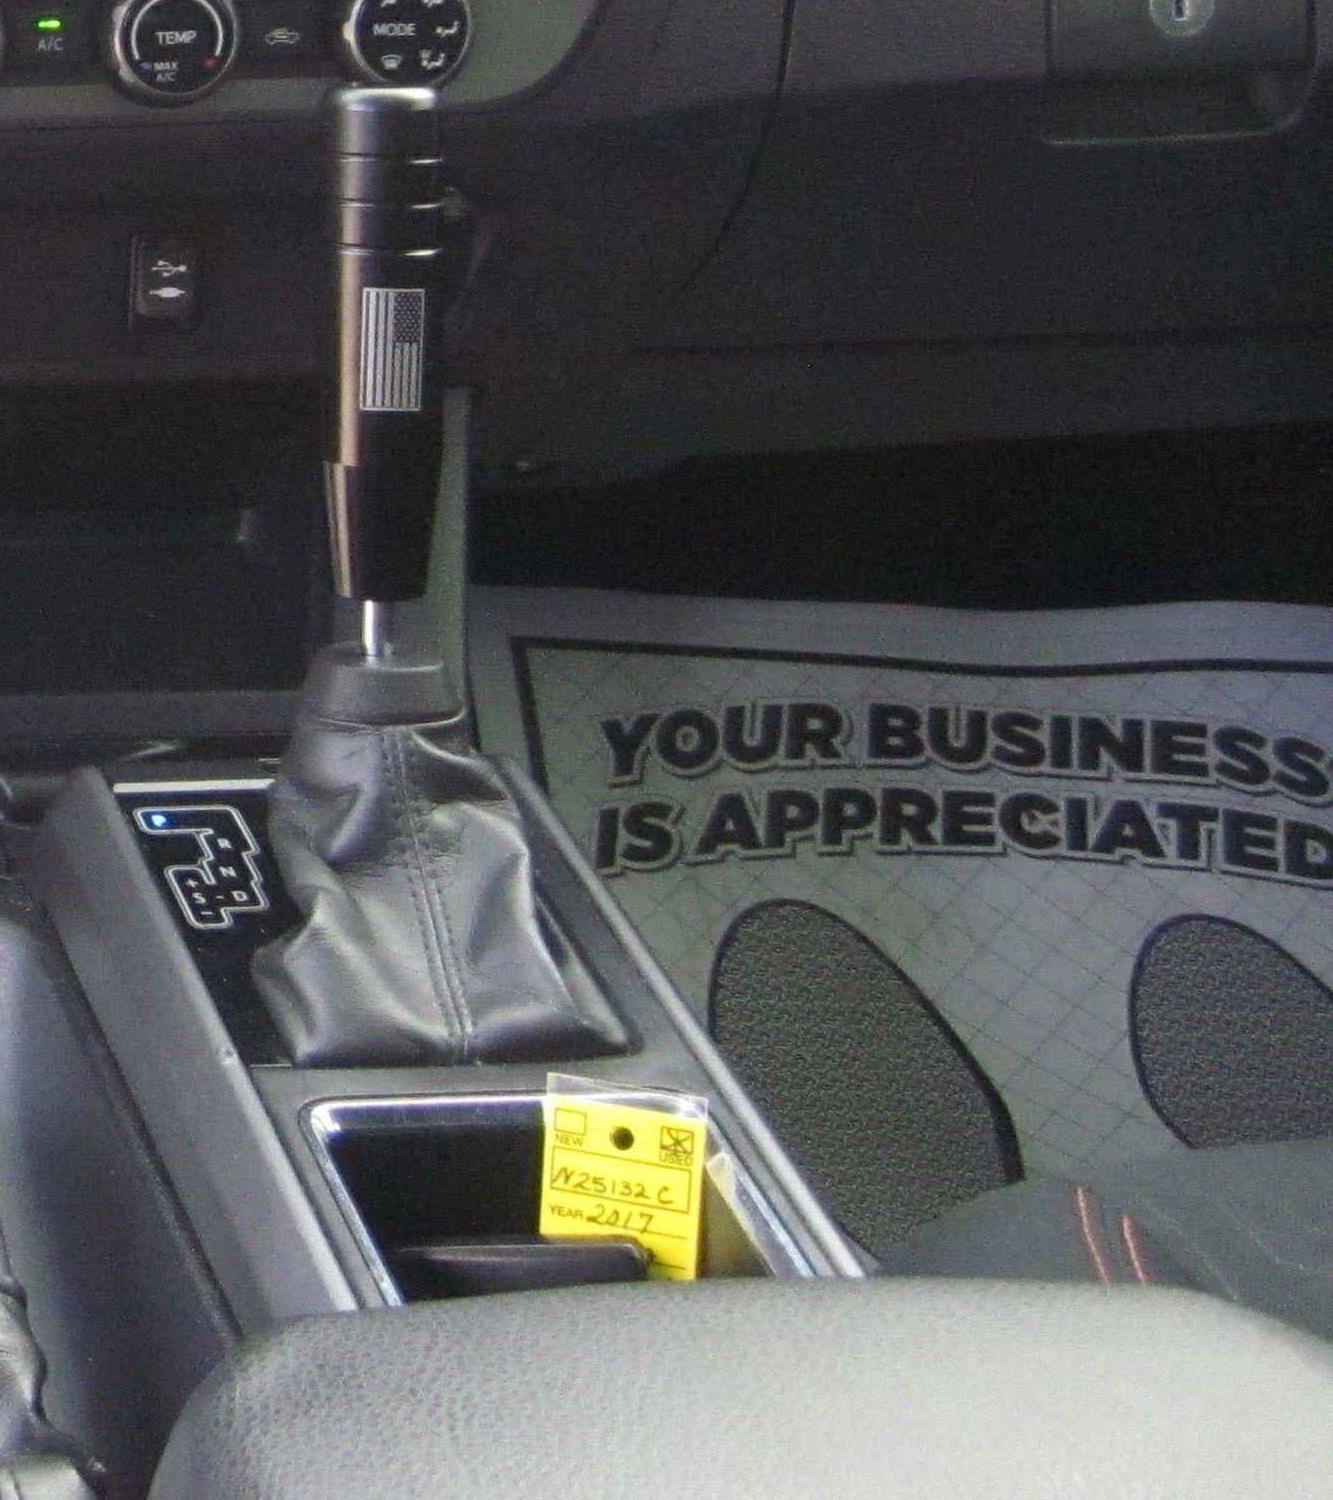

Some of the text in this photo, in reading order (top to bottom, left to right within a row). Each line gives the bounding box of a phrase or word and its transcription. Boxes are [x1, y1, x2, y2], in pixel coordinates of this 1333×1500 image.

[373, 23, 416, 35] MODE
[37, 37, 64, 51] A/C
[155, 30, 197, 45] TEMP
[597, 702, 1331, 798] YOUR BUSINESS
[596, 802, 681, 870] IS
[217, 838, 232, 850] R
[219, 866, 237, 878] N
[232, 890, 248, 902] D
[554, 1133, 583, 1146] NEW
[659, 1152, 693, 1166] USED
[549, 1203, 653, 1235] YEAR 2017
